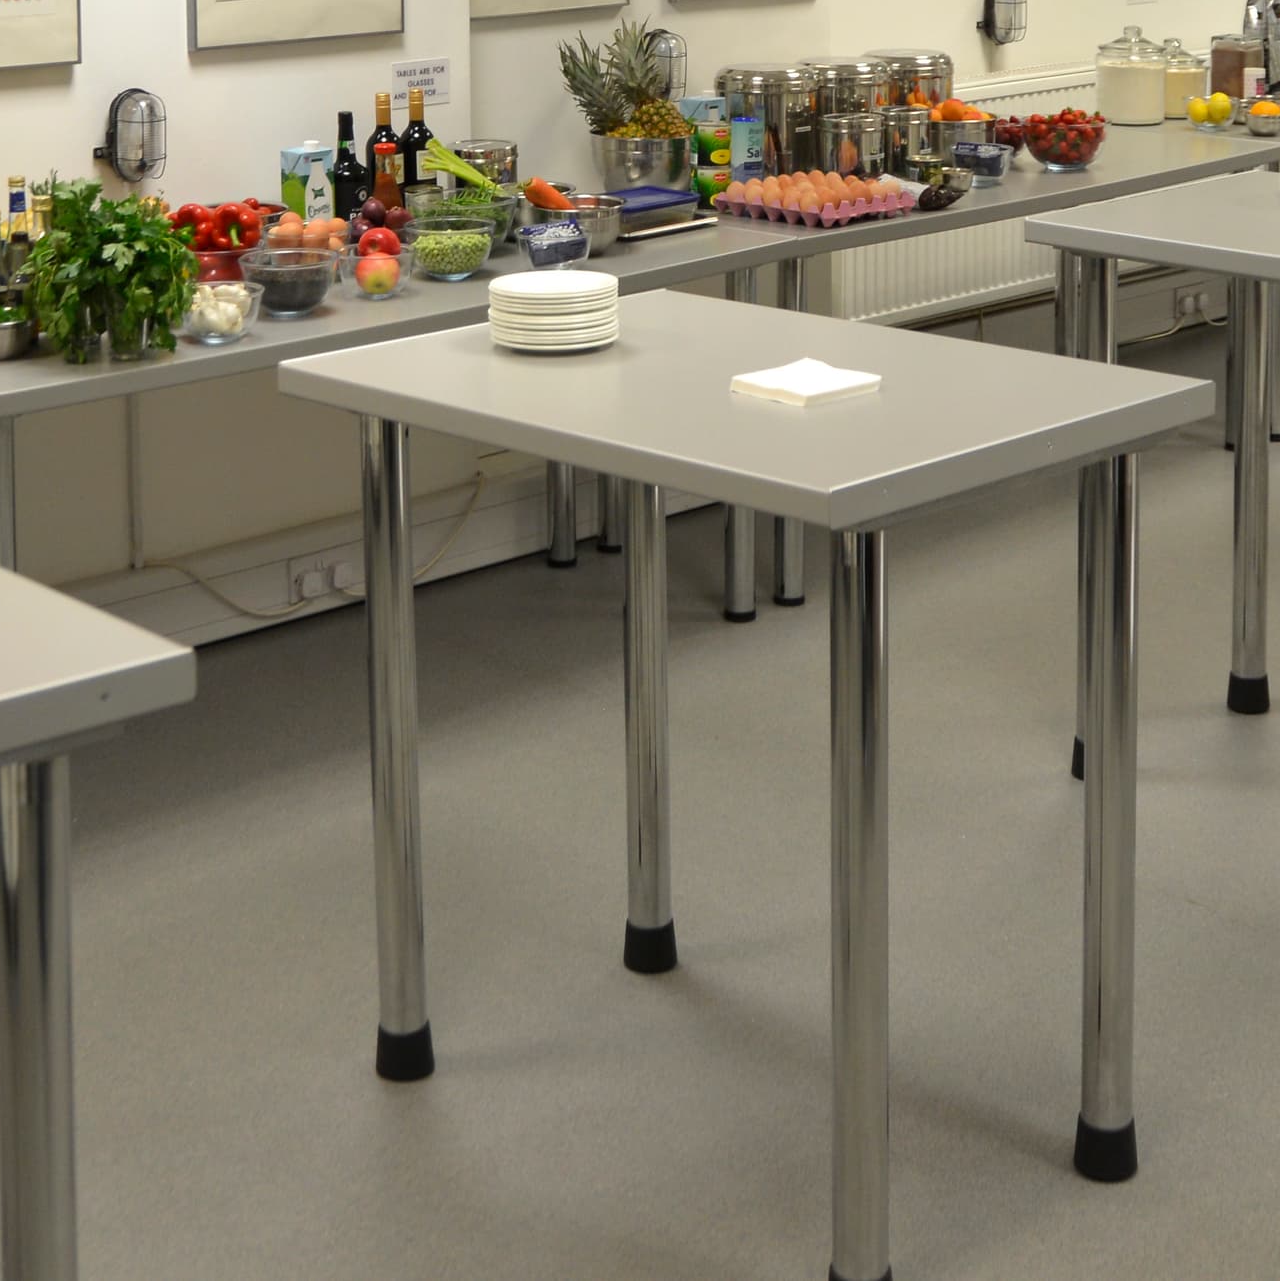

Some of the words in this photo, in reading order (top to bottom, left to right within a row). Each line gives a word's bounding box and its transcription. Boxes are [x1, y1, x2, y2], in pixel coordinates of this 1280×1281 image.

[396, 68, 417, 77] TABLES
[419, 67, 431, 75] ARE
[432, 65, 445, 74] FOR
[407, 77, 434, 87] GLASSES
[393, 92, 408, 100] AND
